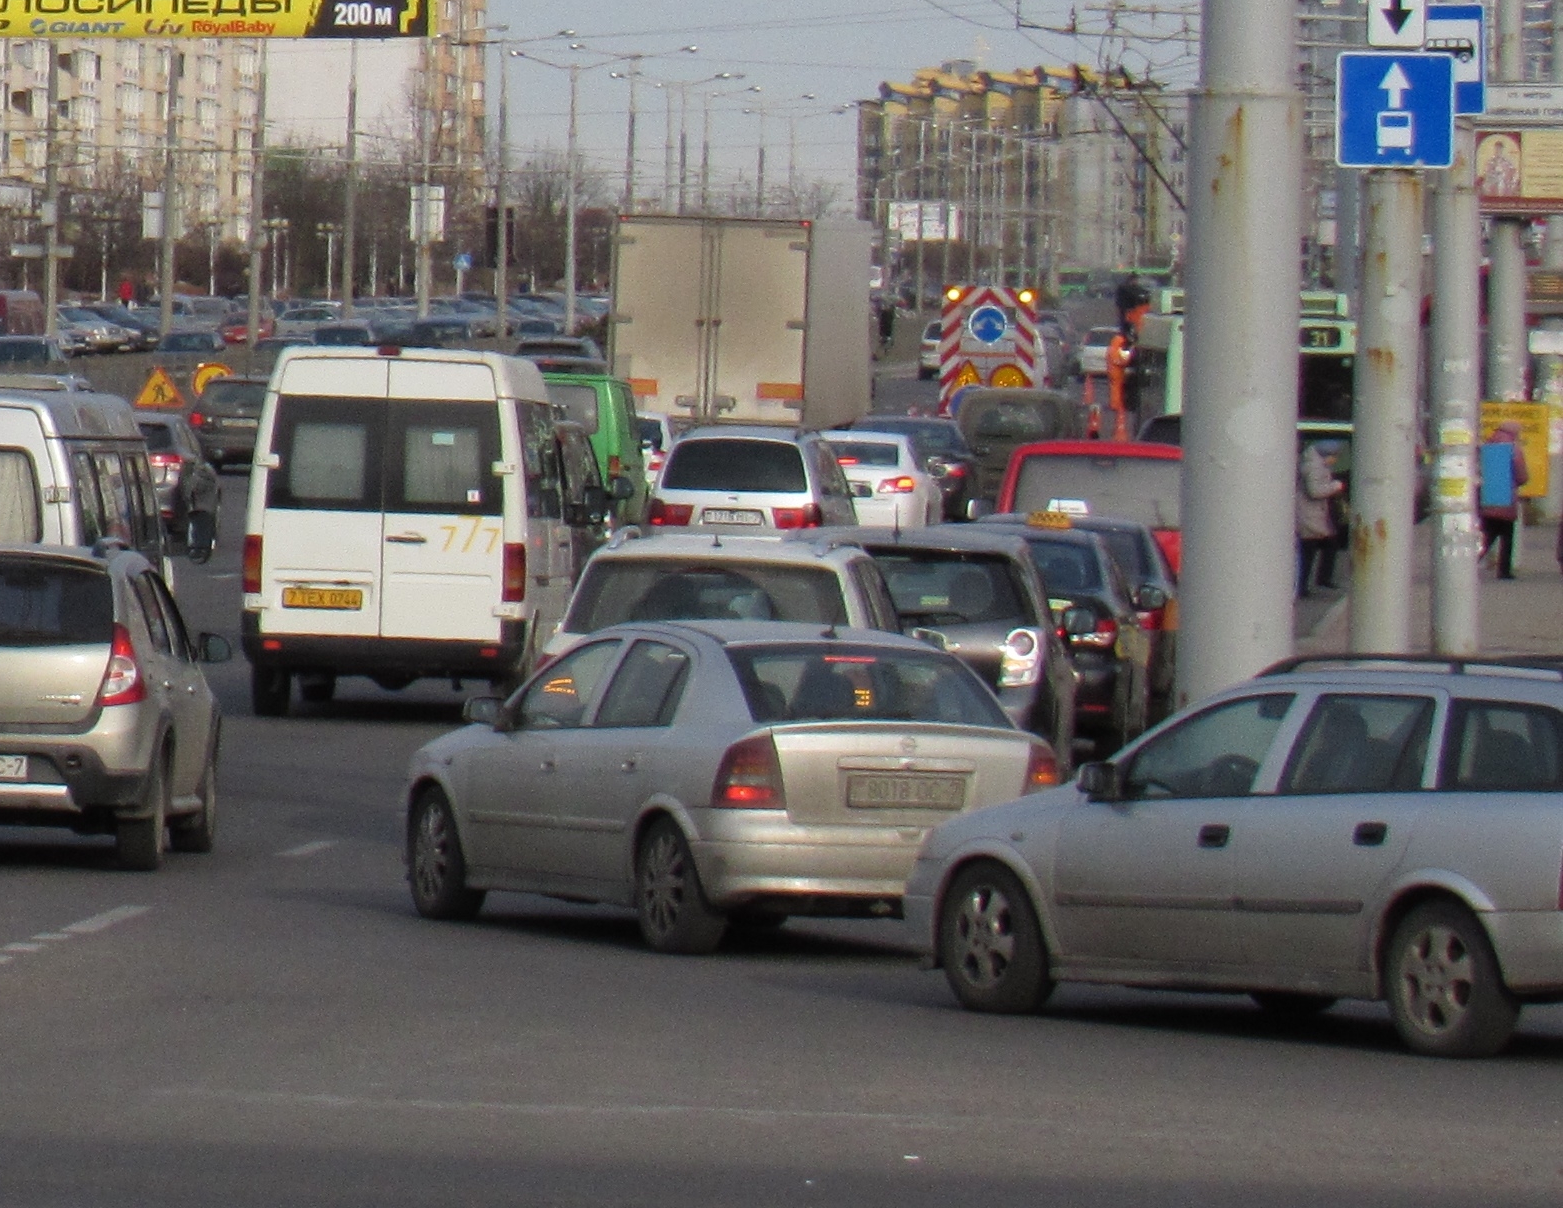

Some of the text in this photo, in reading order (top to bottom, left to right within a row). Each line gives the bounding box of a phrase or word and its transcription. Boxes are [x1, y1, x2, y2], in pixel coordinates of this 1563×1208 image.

[48, 21, 126, 34] GIANT
[191, 20, 276, 35] RoyalBaby
[440, 515, 501, 553] 777
